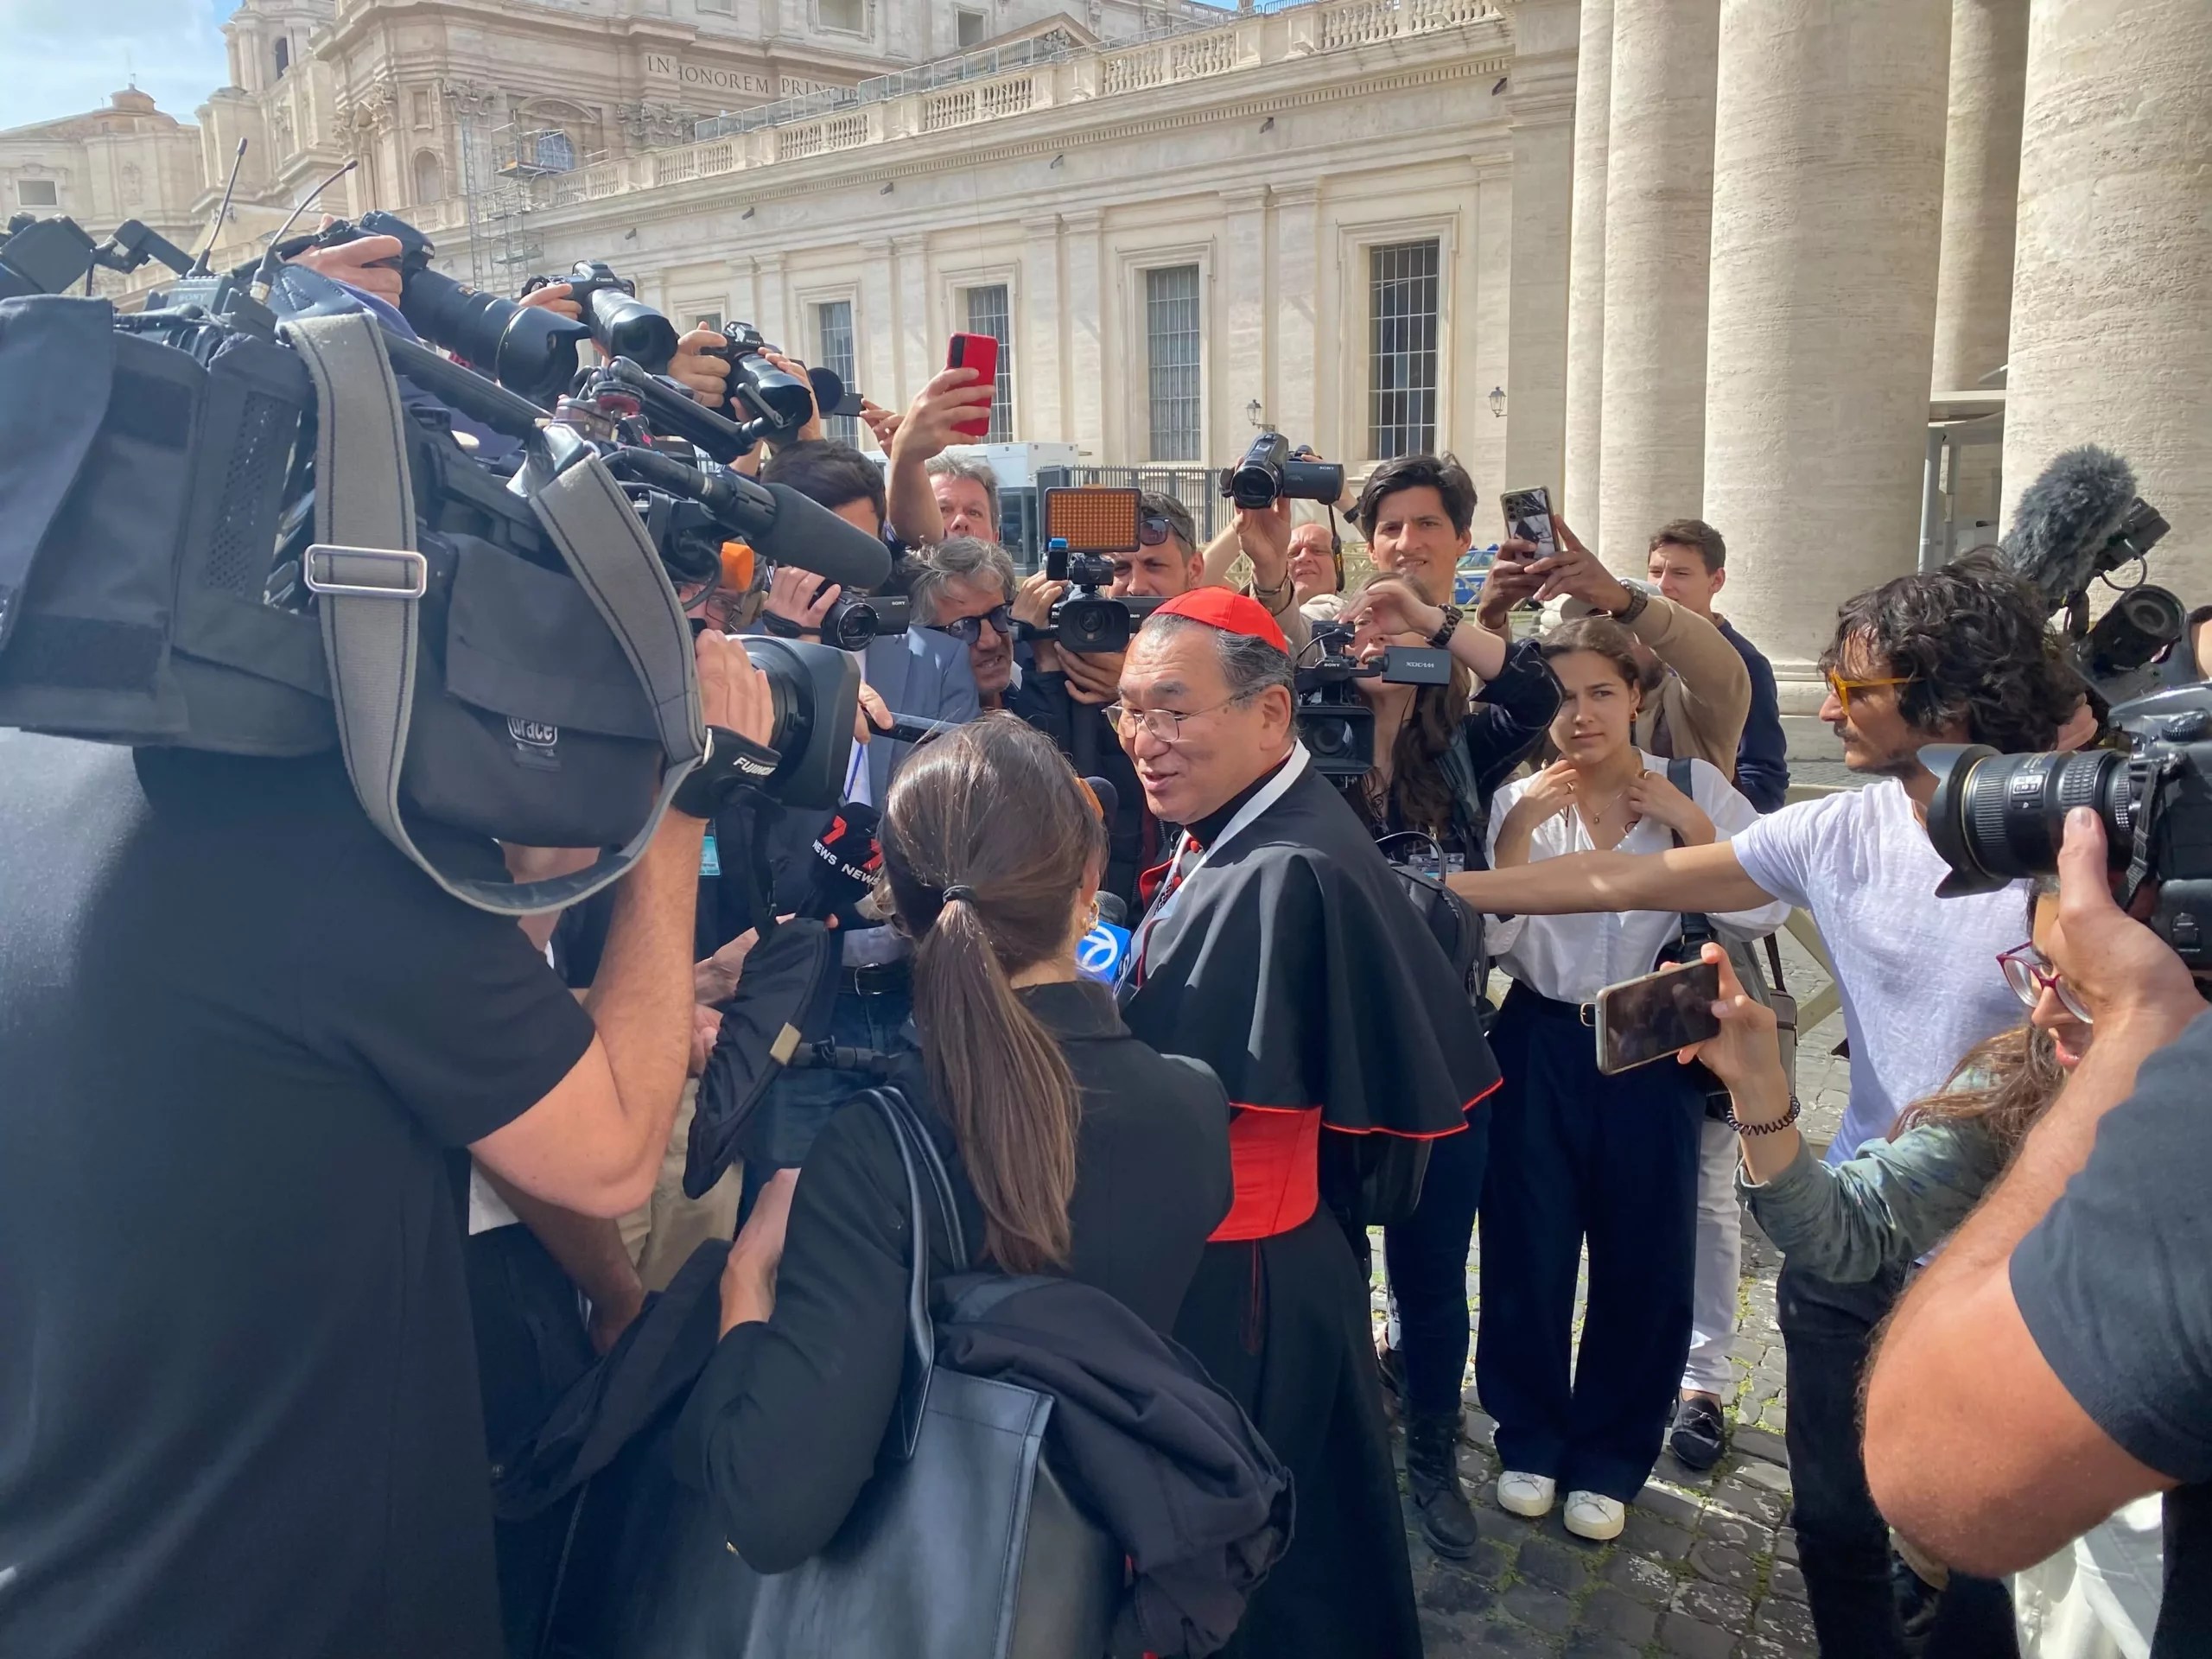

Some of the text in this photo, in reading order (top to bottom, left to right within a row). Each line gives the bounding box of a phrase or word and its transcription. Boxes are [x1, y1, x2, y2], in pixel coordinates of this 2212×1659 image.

[647, 55, 671, 73] IN
[812, 839, 837, 866] NEWS
[841, 863, 880, 886] NEWS
